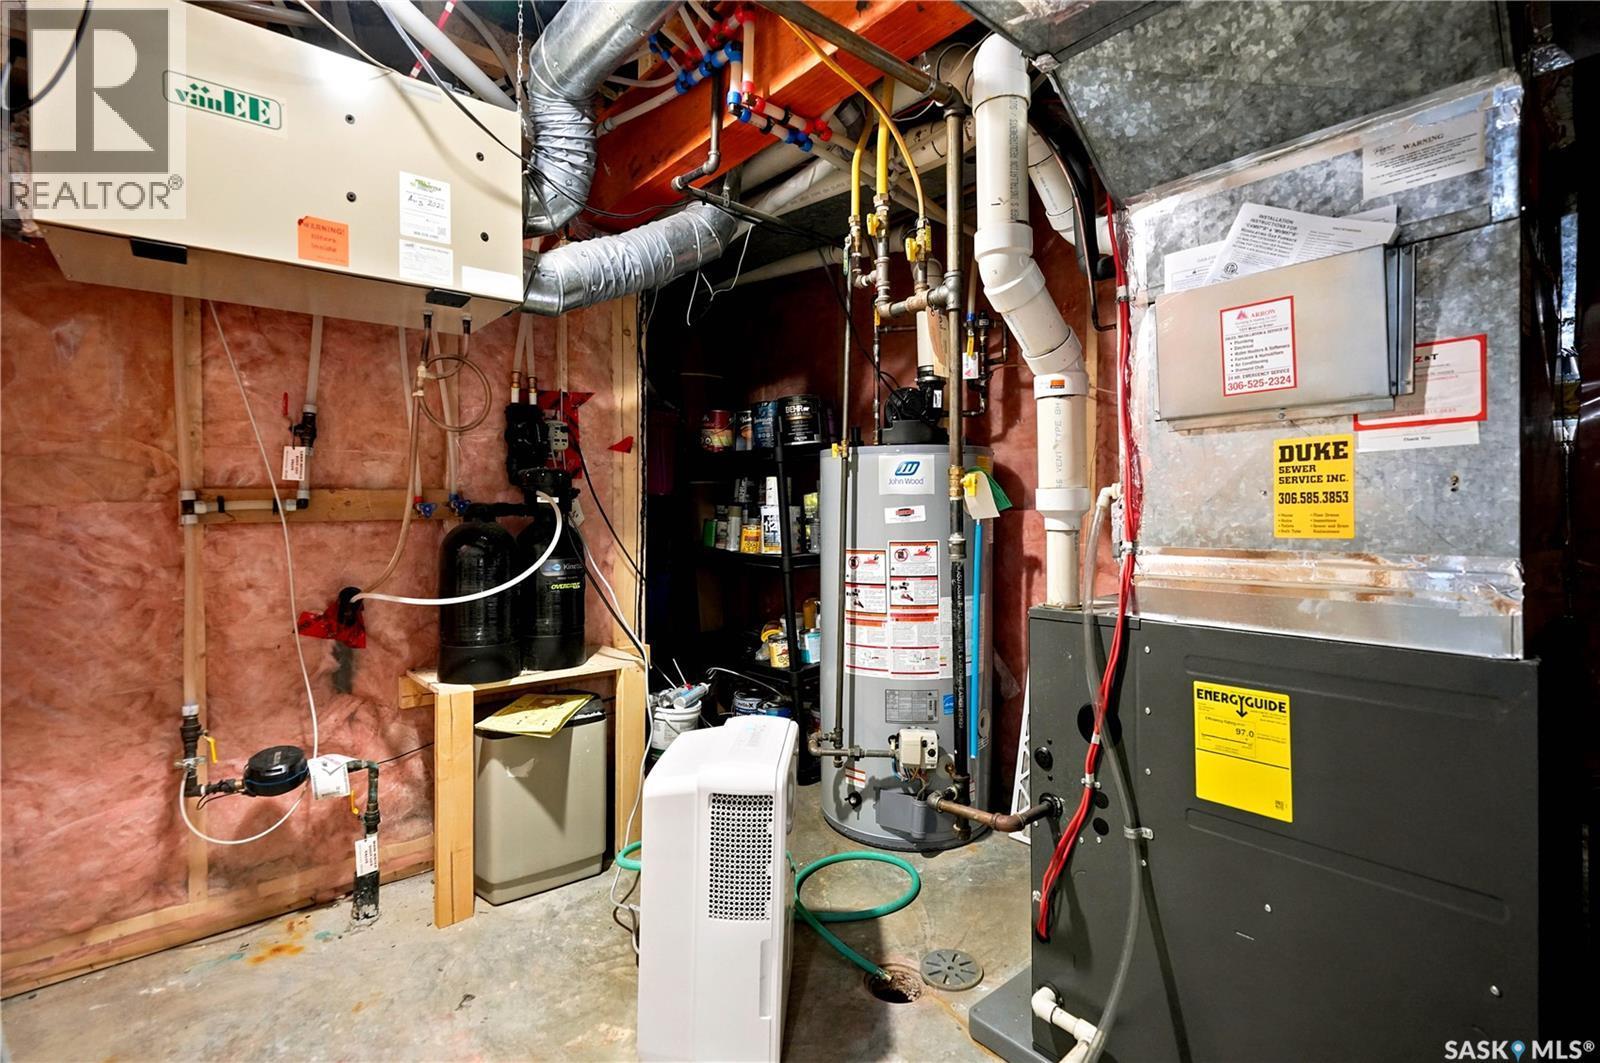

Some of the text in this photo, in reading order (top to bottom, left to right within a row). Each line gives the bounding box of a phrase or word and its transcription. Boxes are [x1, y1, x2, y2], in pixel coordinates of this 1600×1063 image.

[1402, 133, 1444, 150] WARNING
[1227, 375, 1291, 391] 306-525-2324
[1279, 441, 1348, 463] DUKE
[1279, 464, 1316, 474] SEWER
[888, 477, 924, 485] John Wood
[1279, 474, 1349, 485] SERVICE INC.
[1278, 491, 1349, 504] 306.585.3853
[1196, 688, 1287, 714] ENERGYGUIDE
[1235, 727, 1255, 738] 97.0
